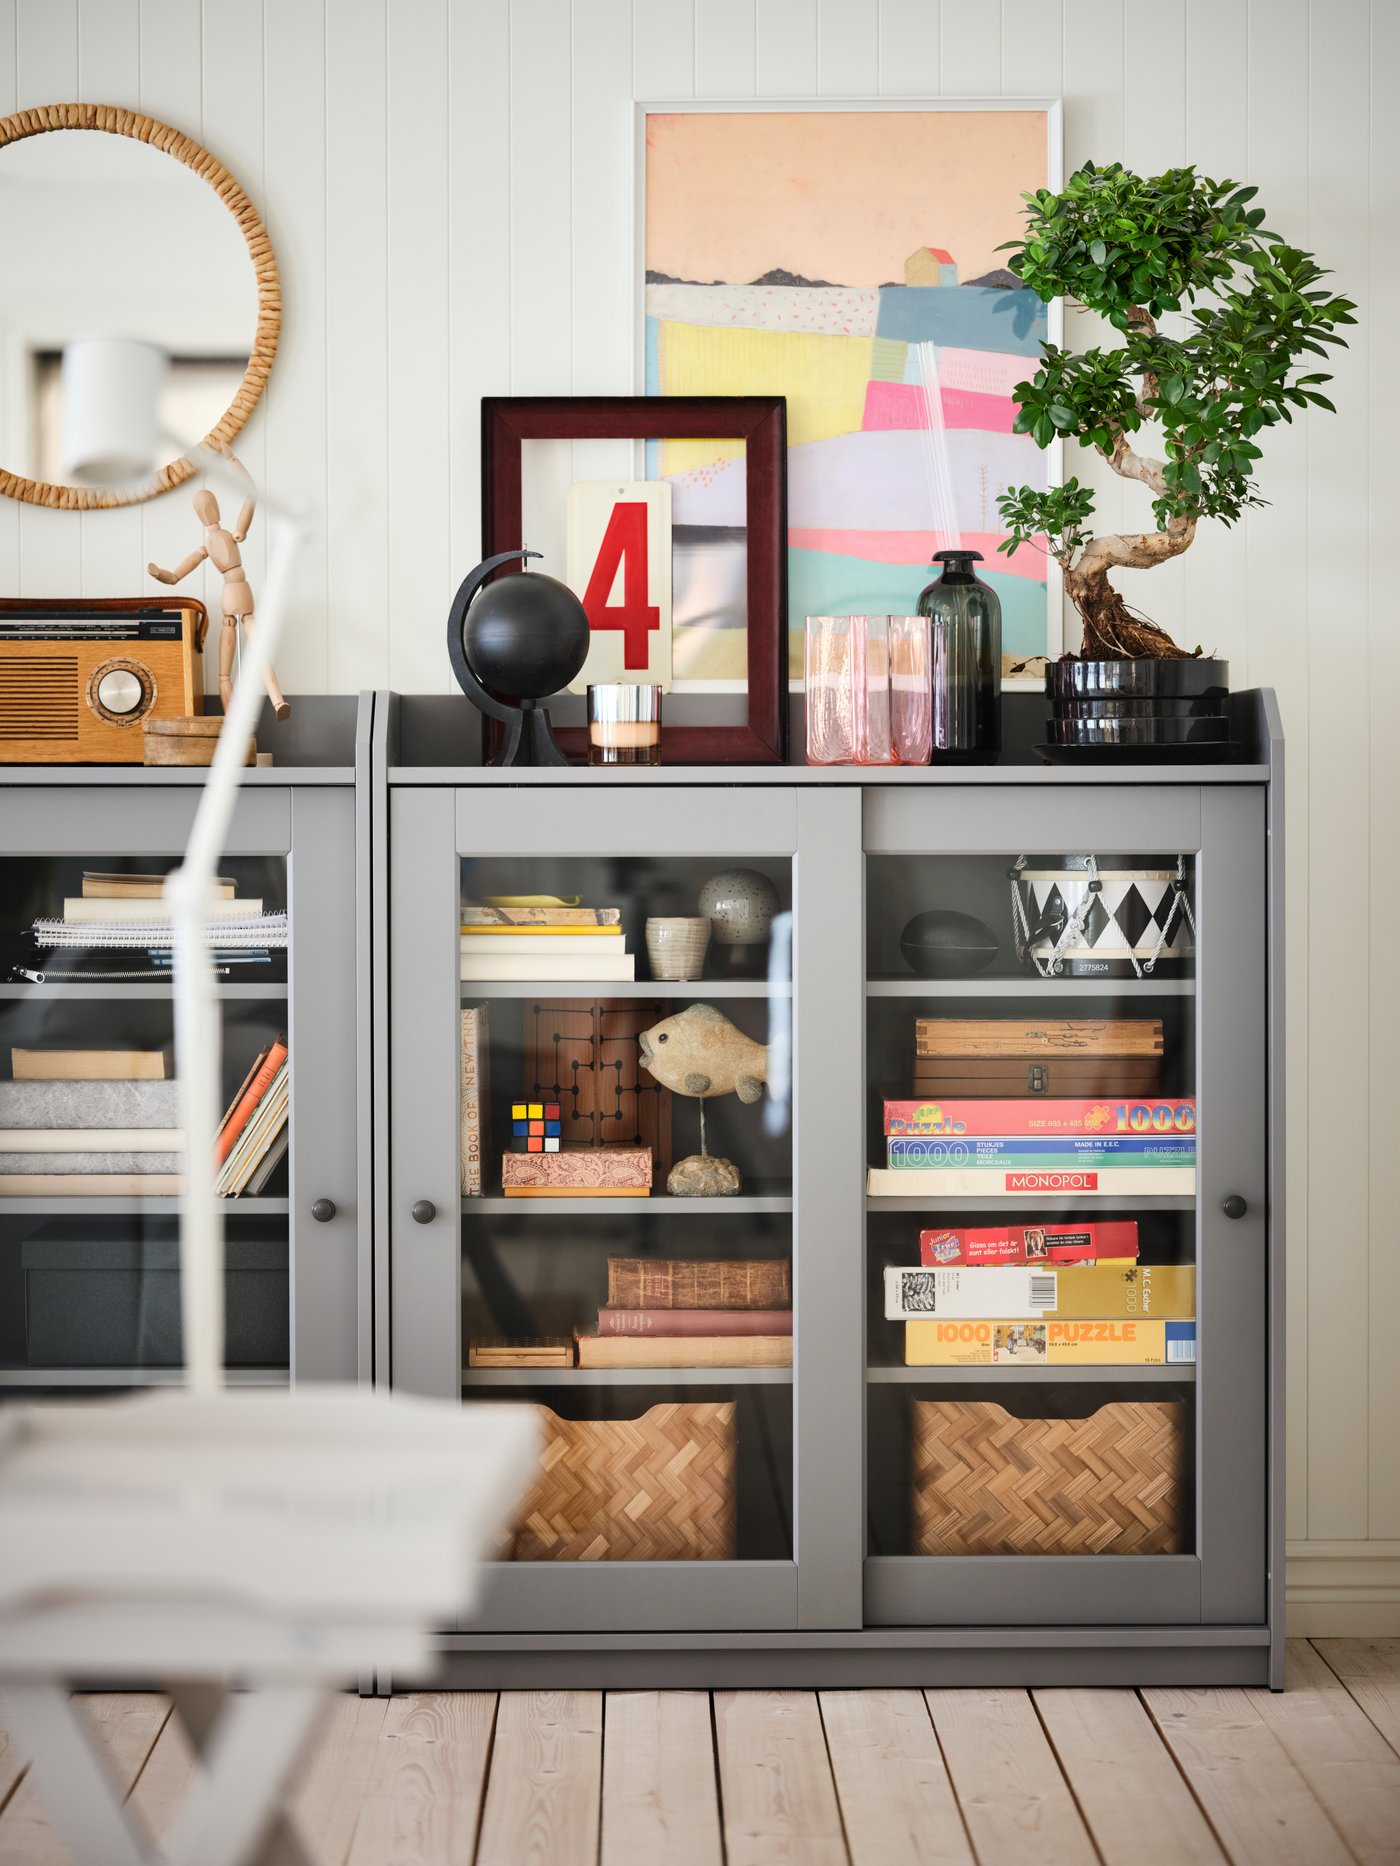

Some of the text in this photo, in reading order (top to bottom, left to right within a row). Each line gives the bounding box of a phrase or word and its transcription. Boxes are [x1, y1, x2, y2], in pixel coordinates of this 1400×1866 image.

[582, 502, 660, 670] 4
[464, 1052, 475, 1086] NEW
[467, 1102, 478, 1120] OF
[1115, 1104, 1196, 1131] 1000
[890, 1115, 967, 1135] Puzzle
[468, 1125, 479, 1162] BOOK
[894, 1141, 969, 1167] 1000
[469, 1168, 480, 1196] THE
[1012, 1175, 1091, 1188] MONOPOL
[929, 1232, 950, 1246] Junior
[1126, 1284, 1137, 1313] 1000
[1142, 1268, 1151, 1313] M.C. Escher
[937, 1323, 990, 1343] 1000
[1048, 1323, 1137, 1342] PUZZLE
